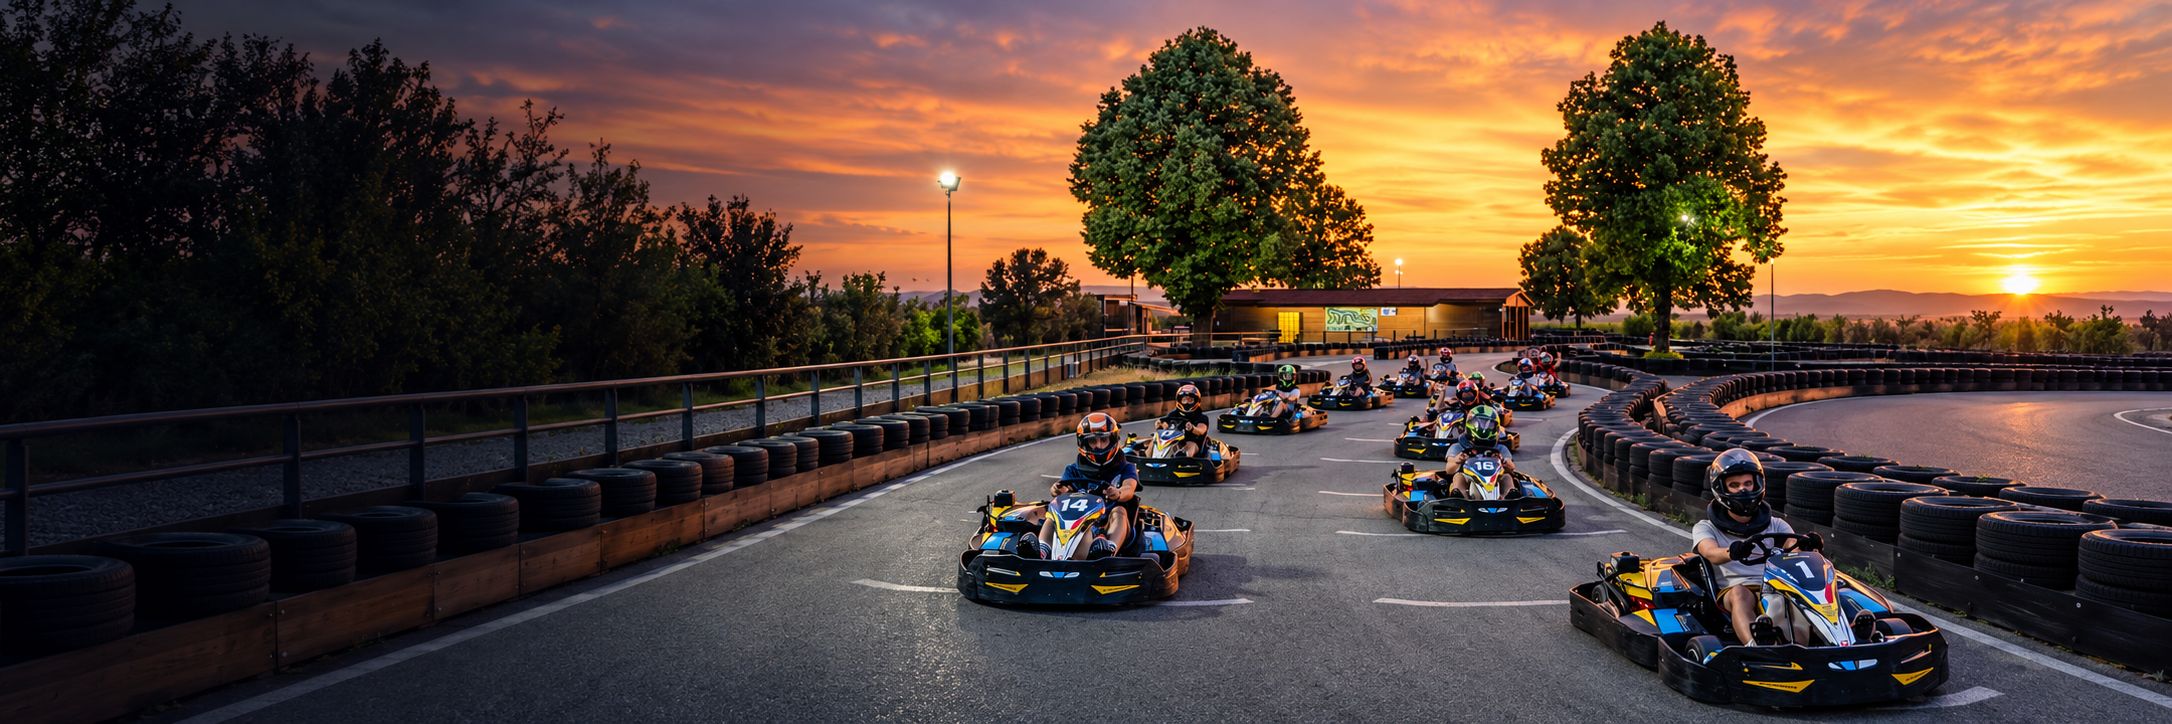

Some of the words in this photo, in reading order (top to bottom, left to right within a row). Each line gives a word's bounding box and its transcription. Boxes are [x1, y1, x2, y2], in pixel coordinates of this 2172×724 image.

[1475, 461, 1494, 471] 16
[1061, 499, 1088, 511] 14
[1795, 560, 1815, 578] 1
